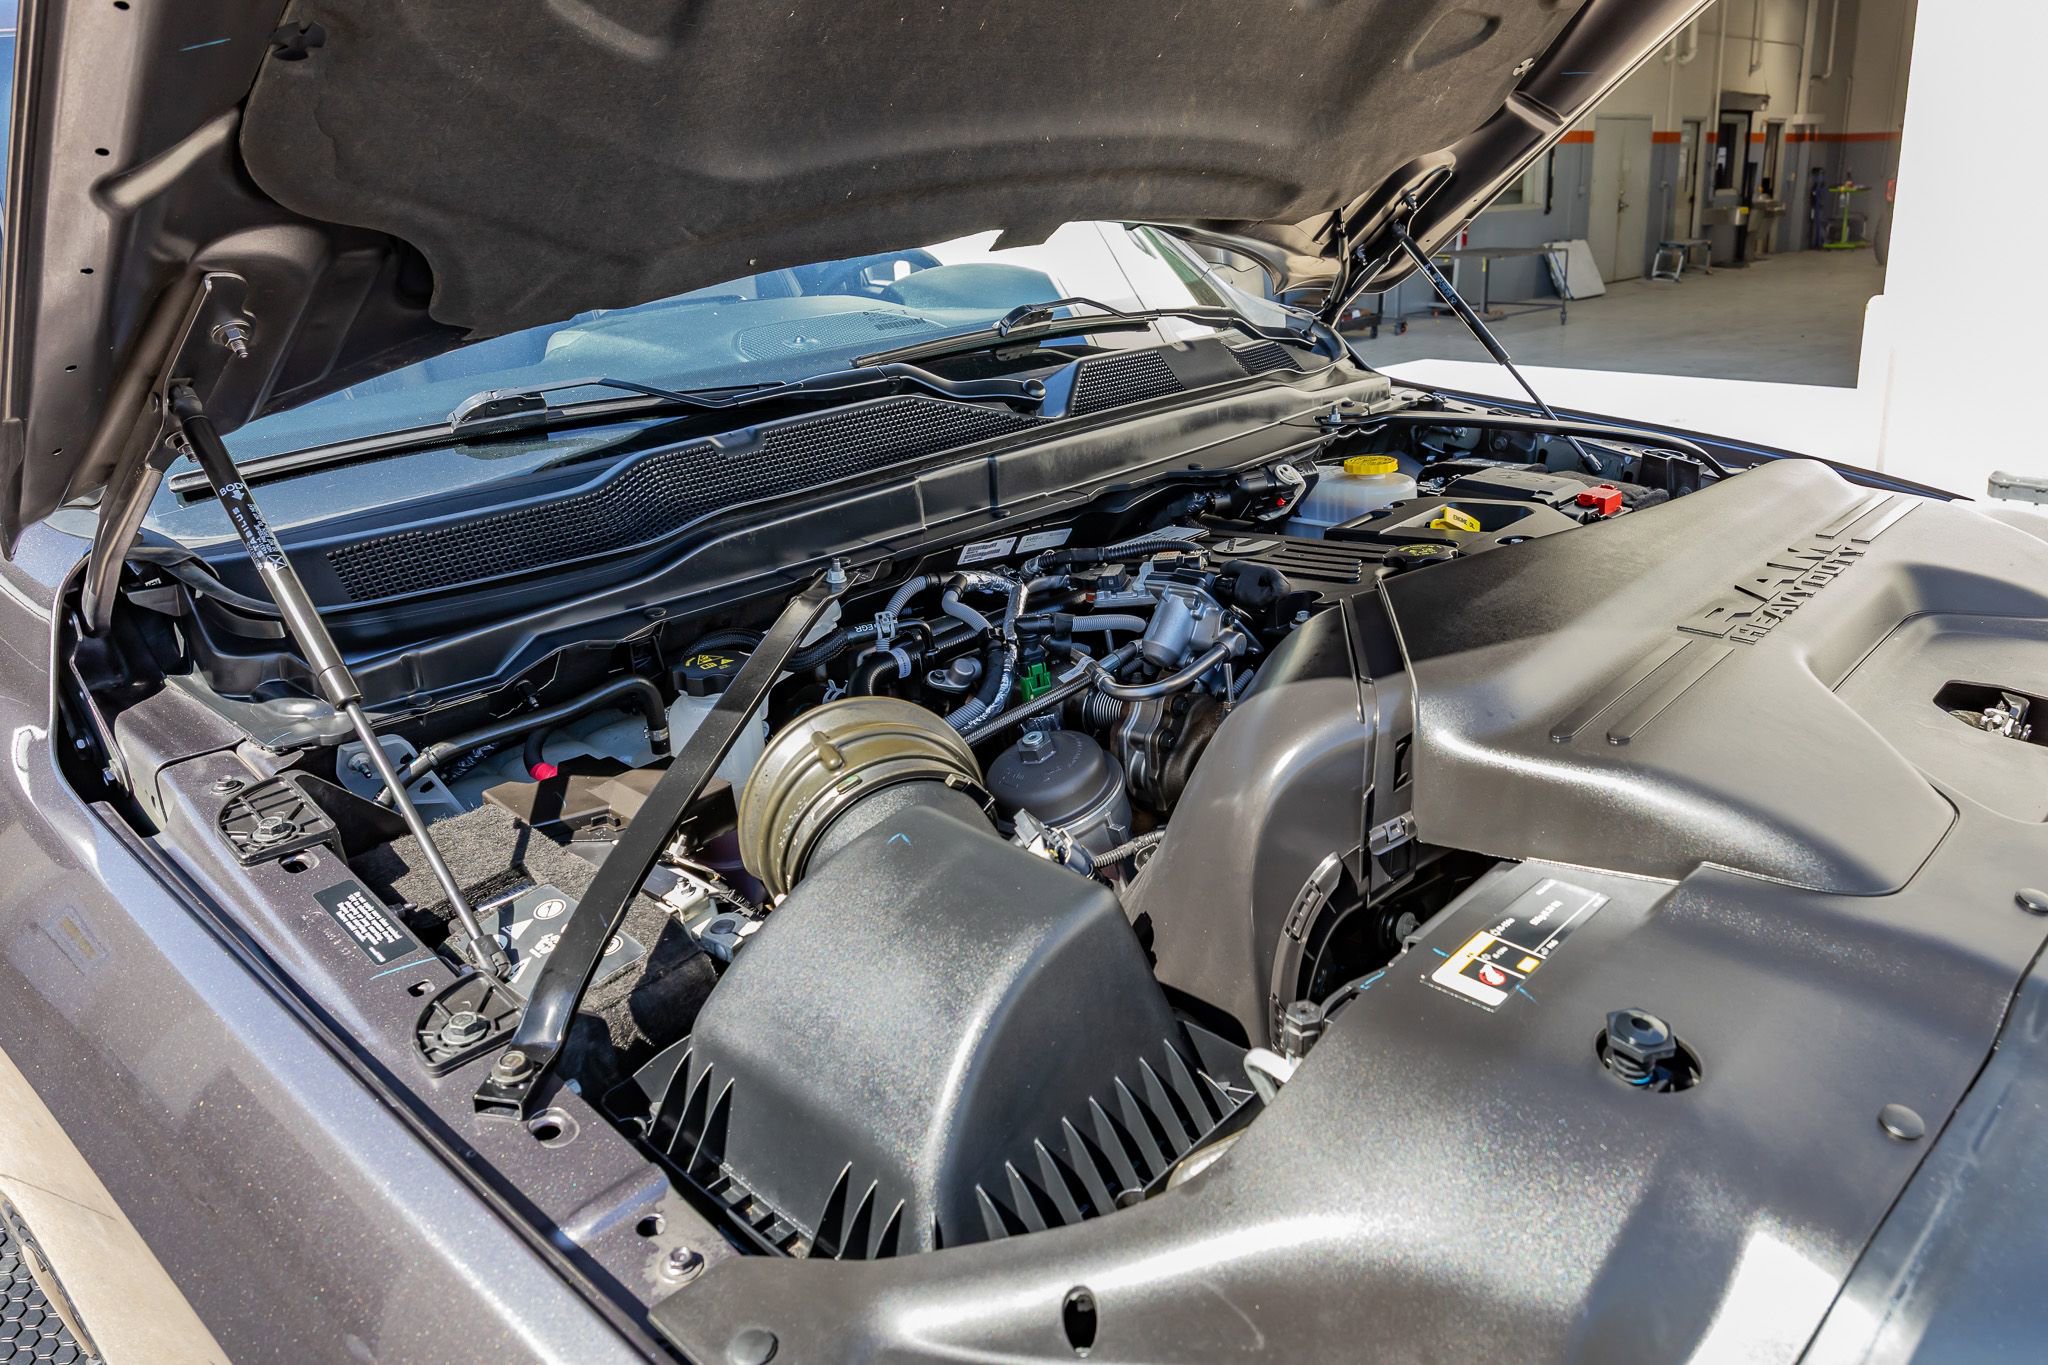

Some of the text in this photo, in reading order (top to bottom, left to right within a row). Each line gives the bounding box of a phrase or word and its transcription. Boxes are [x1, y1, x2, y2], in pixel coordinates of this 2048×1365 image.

[231, 506, 264, 558] STABILUS
[1677, 540, 1842, 638] RAM
[1730, 547, 1867, 645] HEAVY DUTY
[854, 624, 874, 632] EGR
